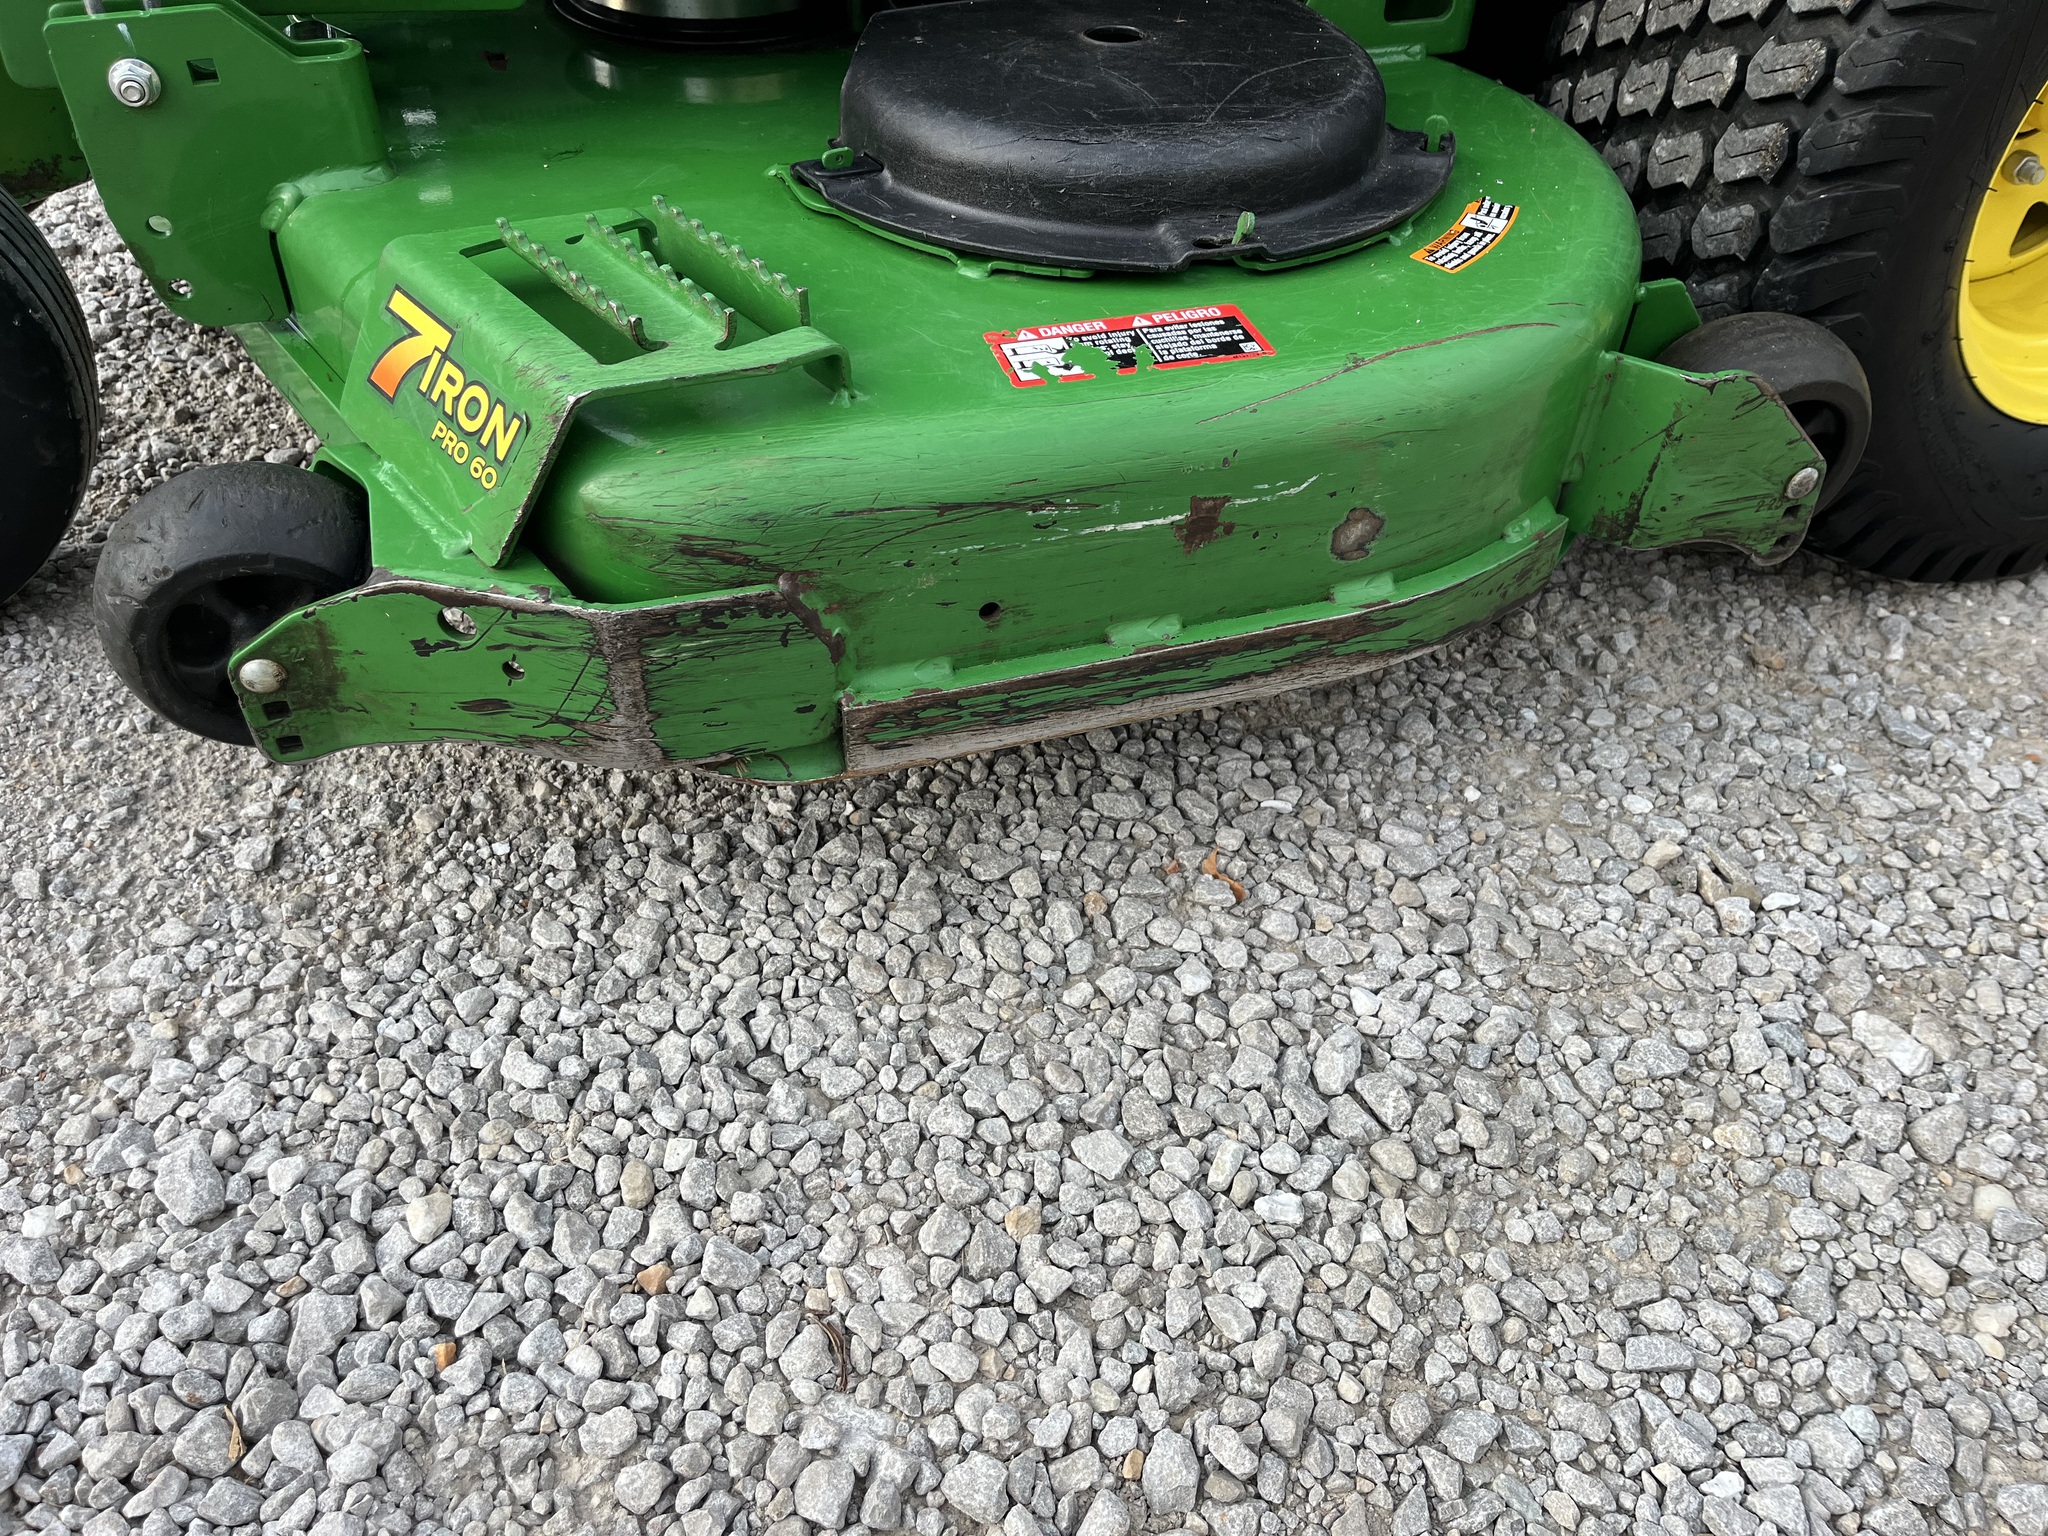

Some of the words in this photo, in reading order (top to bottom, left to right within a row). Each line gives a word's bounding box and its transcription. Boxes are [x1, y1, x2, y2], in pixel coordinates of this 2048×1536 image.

[1152, 307, 1221, 323] PELIGRO
[1038, 321, 1107, 337] DANGER
[1188, 320, 1225, 328] lesiones
[1081, 333, 1107, 341] avoid
[1107, 330, 1135, 339] injury
[1146, 330, 1187, 339] causadas
[1192, 329, 1243, 339] mantenerse
[1094, 336, 1131, 345] rotating
[1155, 341, 1189, 350] alejado
[1169, 344, 1218, 355] plataforma
[368, 285, 455, 403] 7
[418, 348, 523, 466] IRON
[430, 420, 470, 464] PRO
[469, 456, 498, 490] 60
